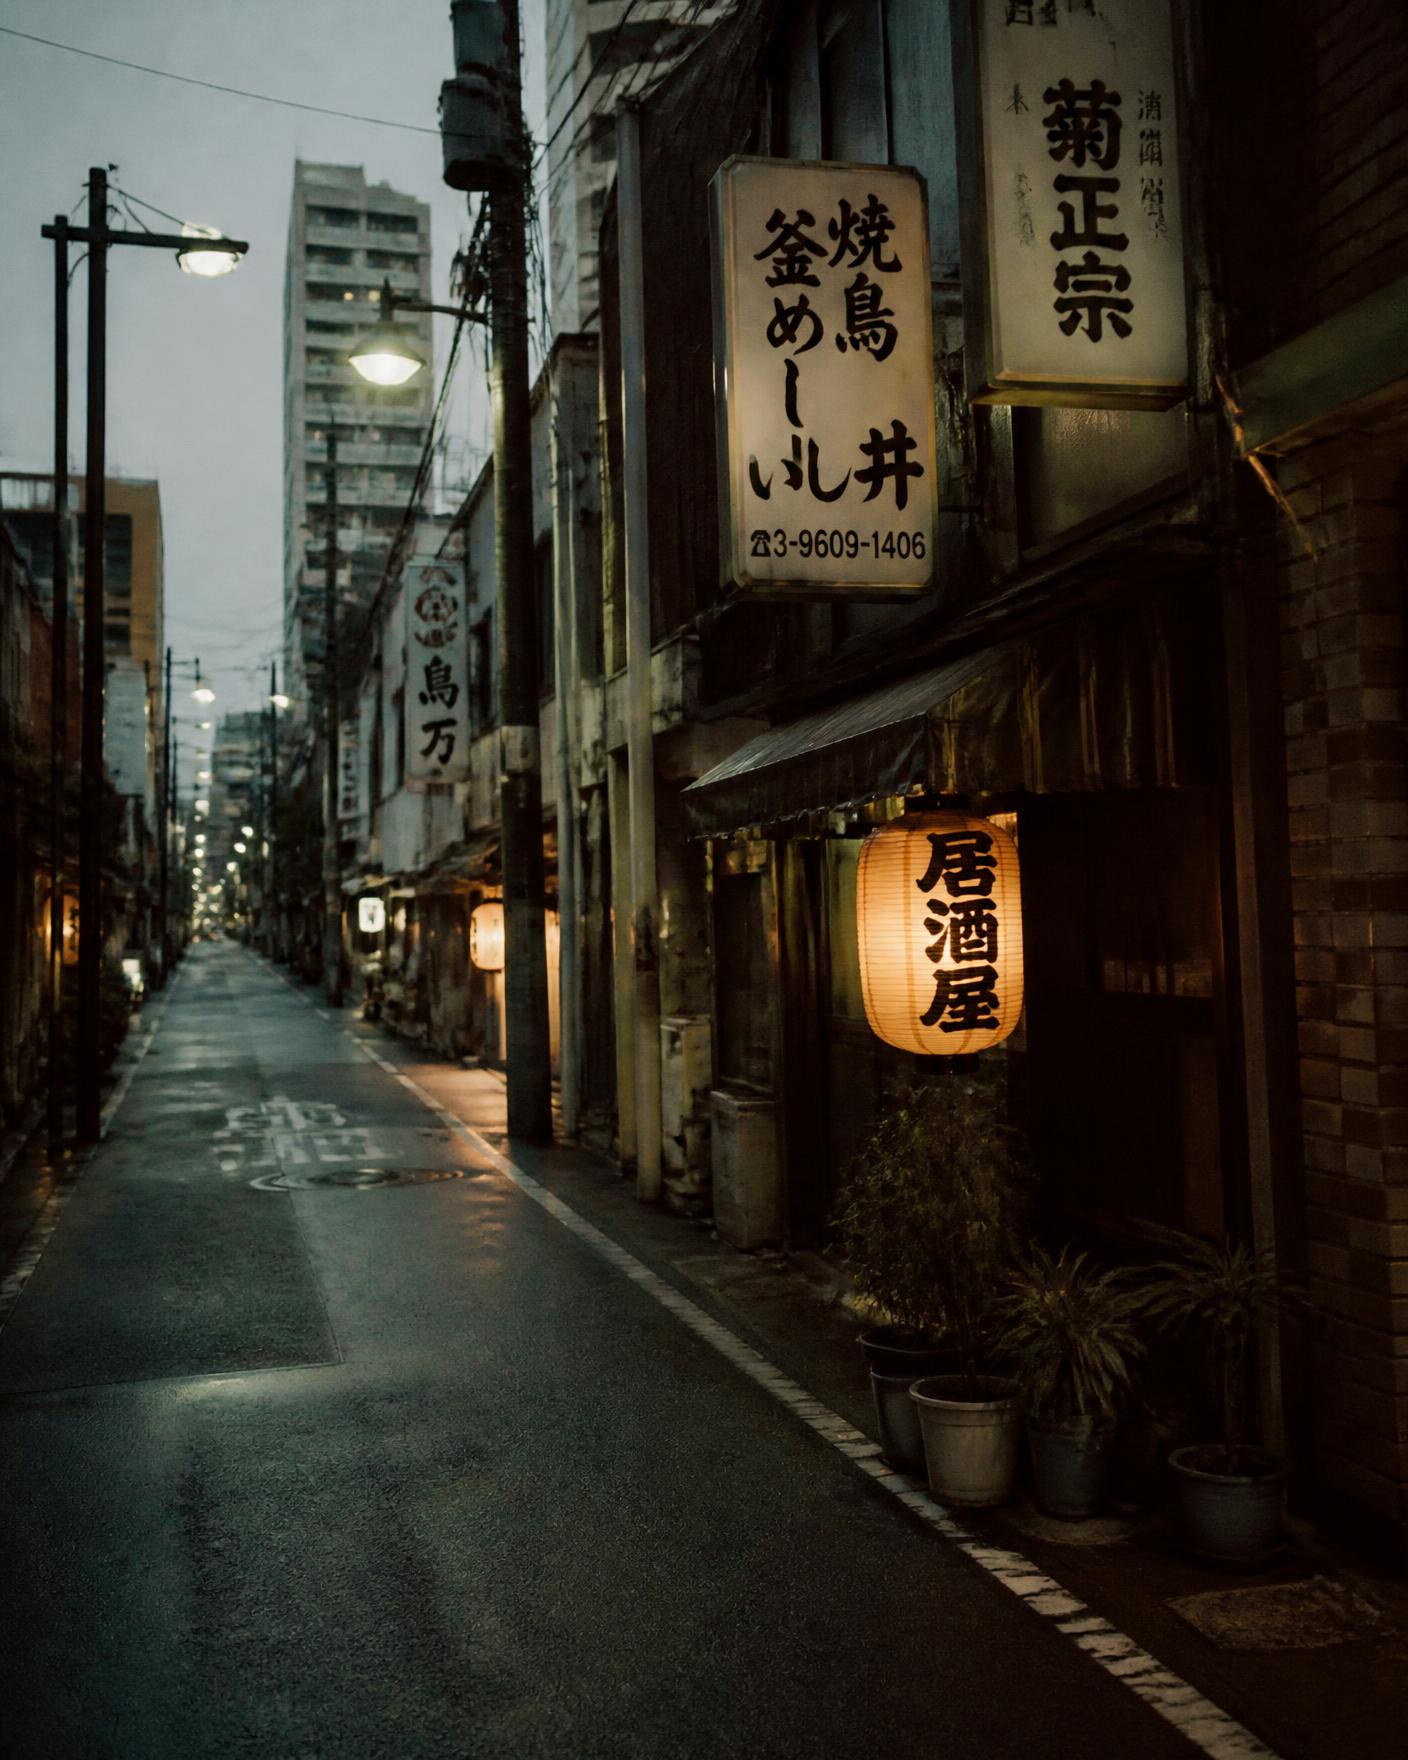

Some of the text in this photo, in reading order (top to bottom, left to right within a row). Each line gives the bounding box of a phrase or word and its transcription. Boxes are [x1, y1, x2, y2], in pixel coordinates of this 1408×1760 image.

[828, 193, 902, 362] 焼鳥
[1042, 78, 1134, 343] 菊正宗
[753, 207, 828, 428] 釜めし
[773, 529, 926, 560] 3-9609-1406
[418, 655, 459, 765] 鳥万
[915, 830, 1001, 1034] 居酒屋
